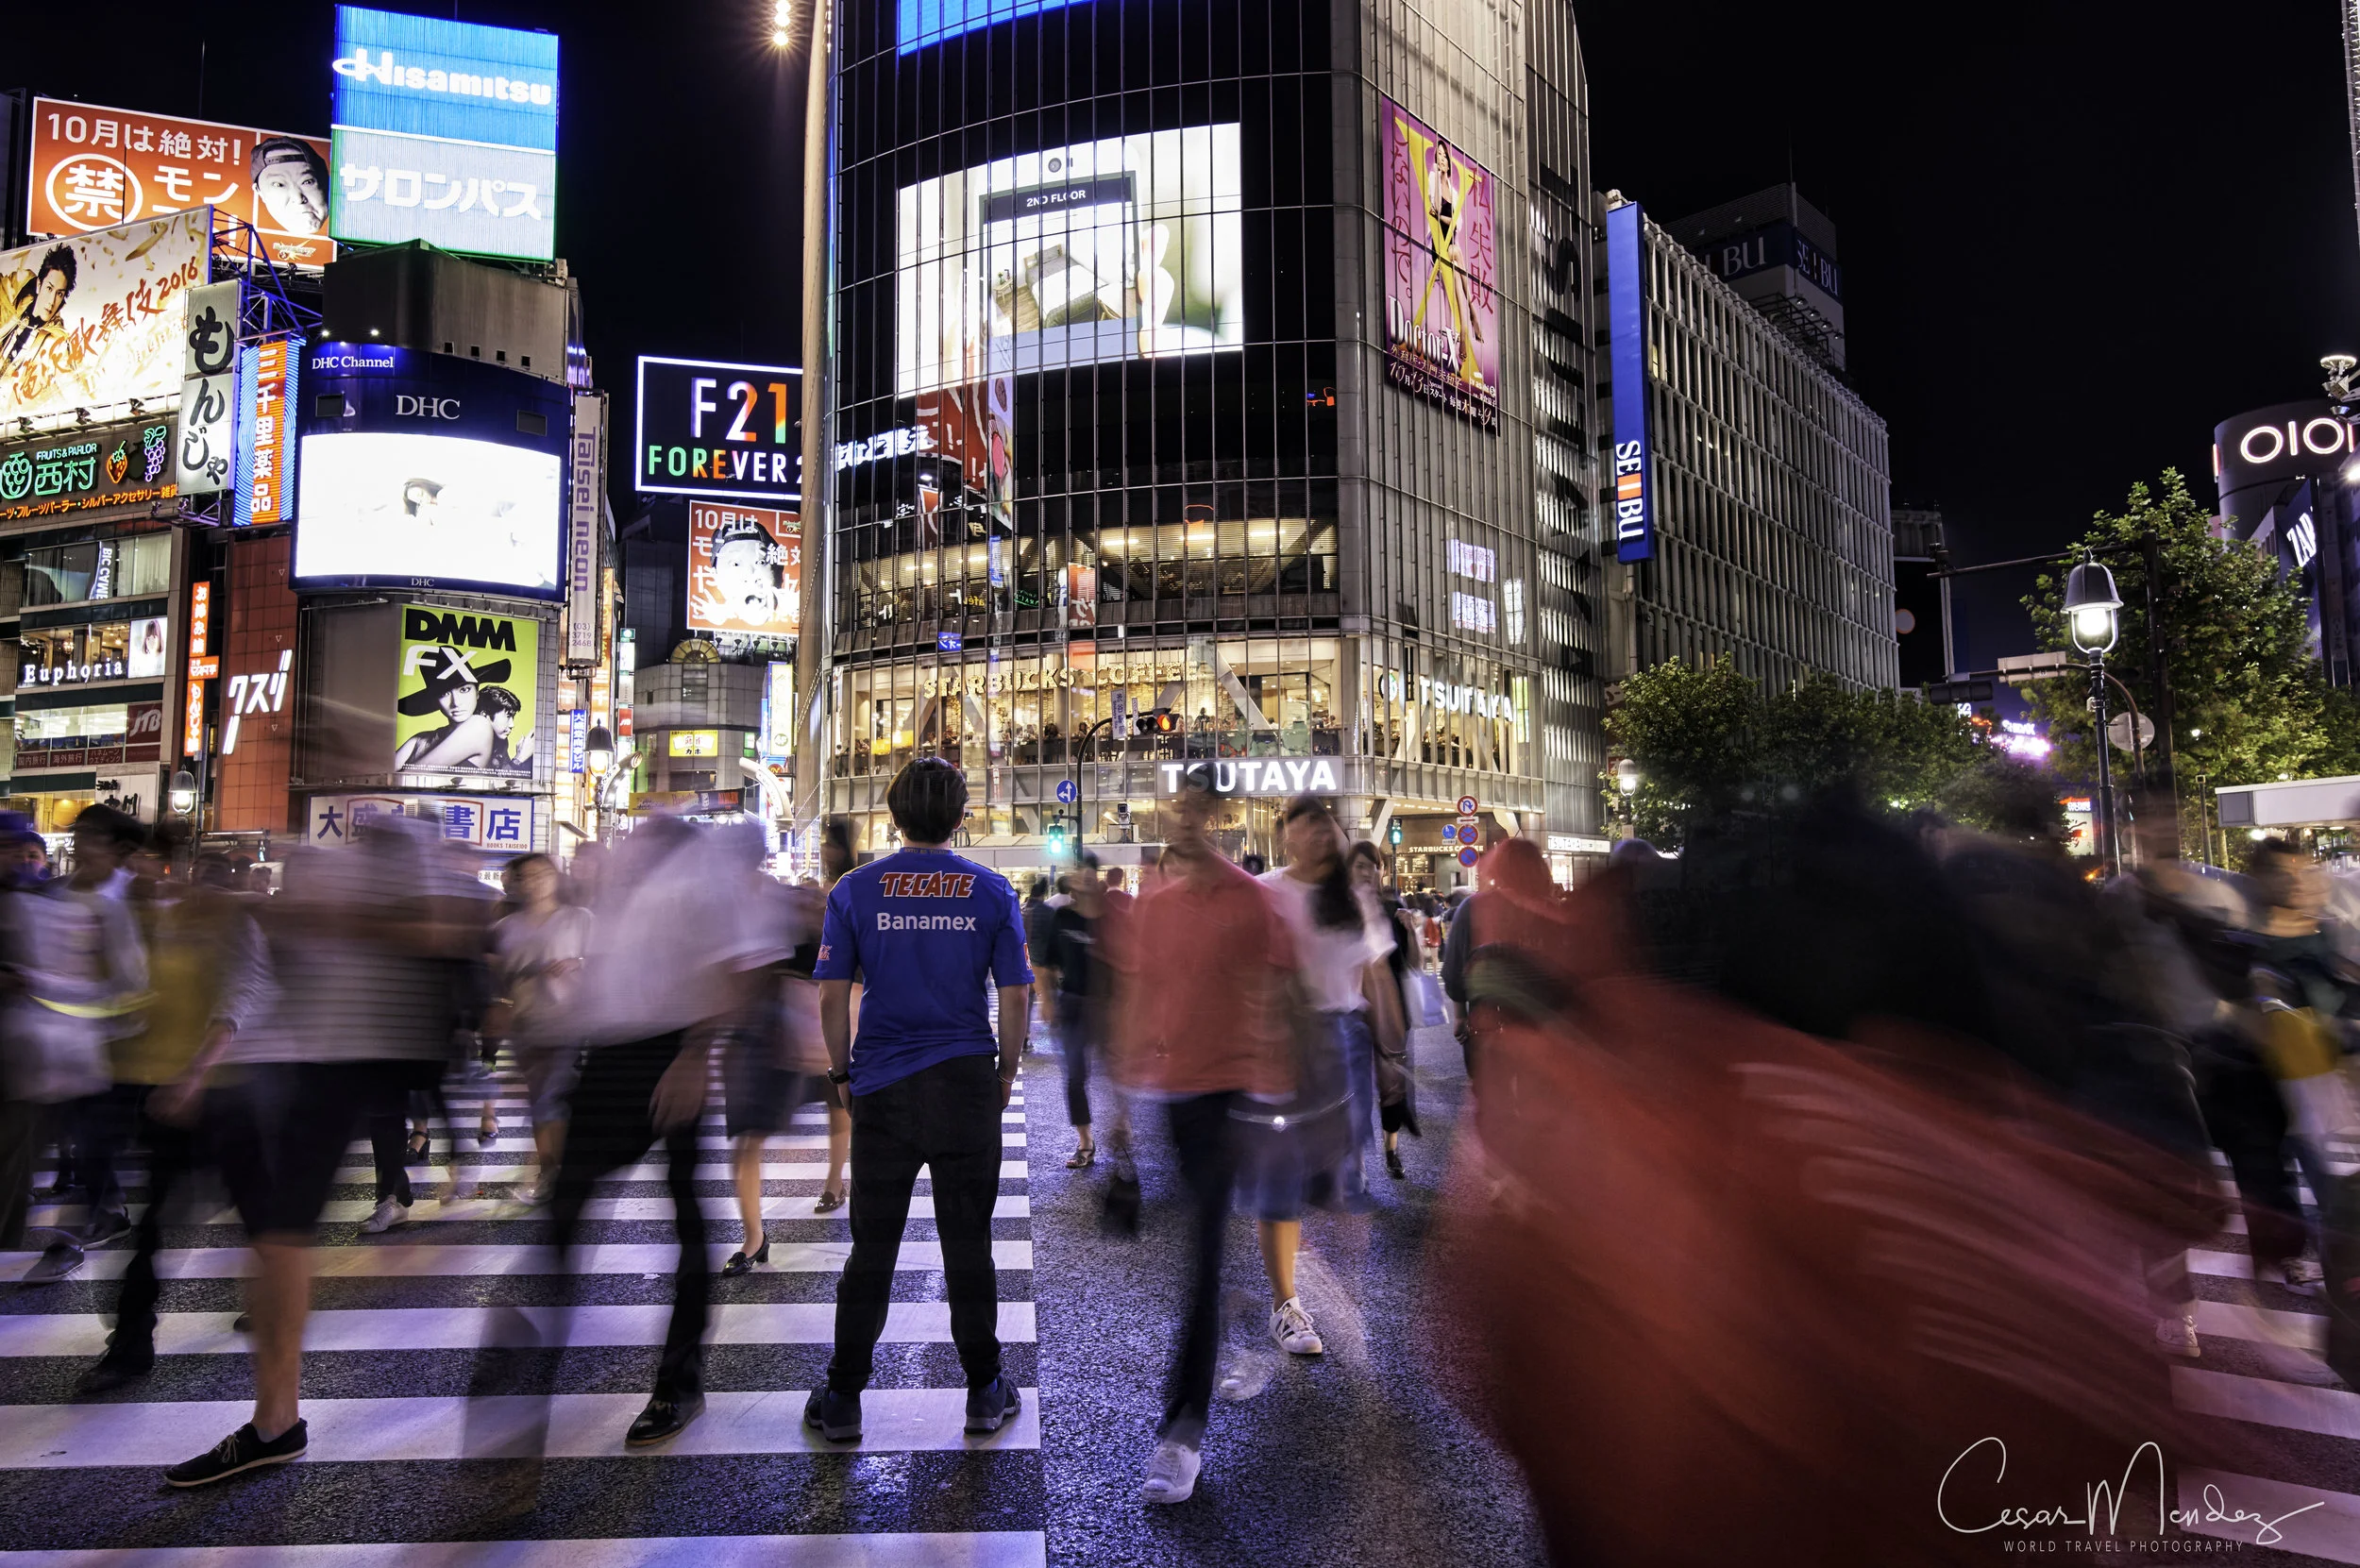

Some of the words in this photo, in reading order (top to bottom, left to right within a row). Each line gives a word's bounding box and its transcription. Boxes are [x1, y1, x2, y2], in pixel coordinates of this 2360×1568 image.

[332, 48, 551, 105] Hisamitsu
[340, 163, 542, 221] サロンパス
[1026, 195, 1049, 207] 2ND
[157, 256, 198, 301] 2016
[312, 357, 339, 369] DHC
[341, 356, 394, 369] Channel
[182, 306, 235, 485] もんじゃ
[396, 395, 461, 420] DHC
[690, 378, 787, 444] F21
[34, 457, 96, 497] 西村
[649, 446, 787, 483] FOREVER
[1615, 440, 1644, 541] SEIBU
[575, 520, 589, 592] neon
[411, 577, 434, 587] DHC
[404, 607, 517, 652] DMM
[24, 658, 123, 686] Euphoria
[403, 645, 478, 683] FX
[923, 666, 1075, 700] STARBUCKS
[1095, 660, 1198, 685] COFFEE
[1419, 675, 1513, 722] TSUTAYA
[129, 709, 161, 737] JTB
[1161, 760, 1337, 793] TSUTAYA
[879, 870, 977, 899] TECATE
[877, 912, 977, 932] Banamex
